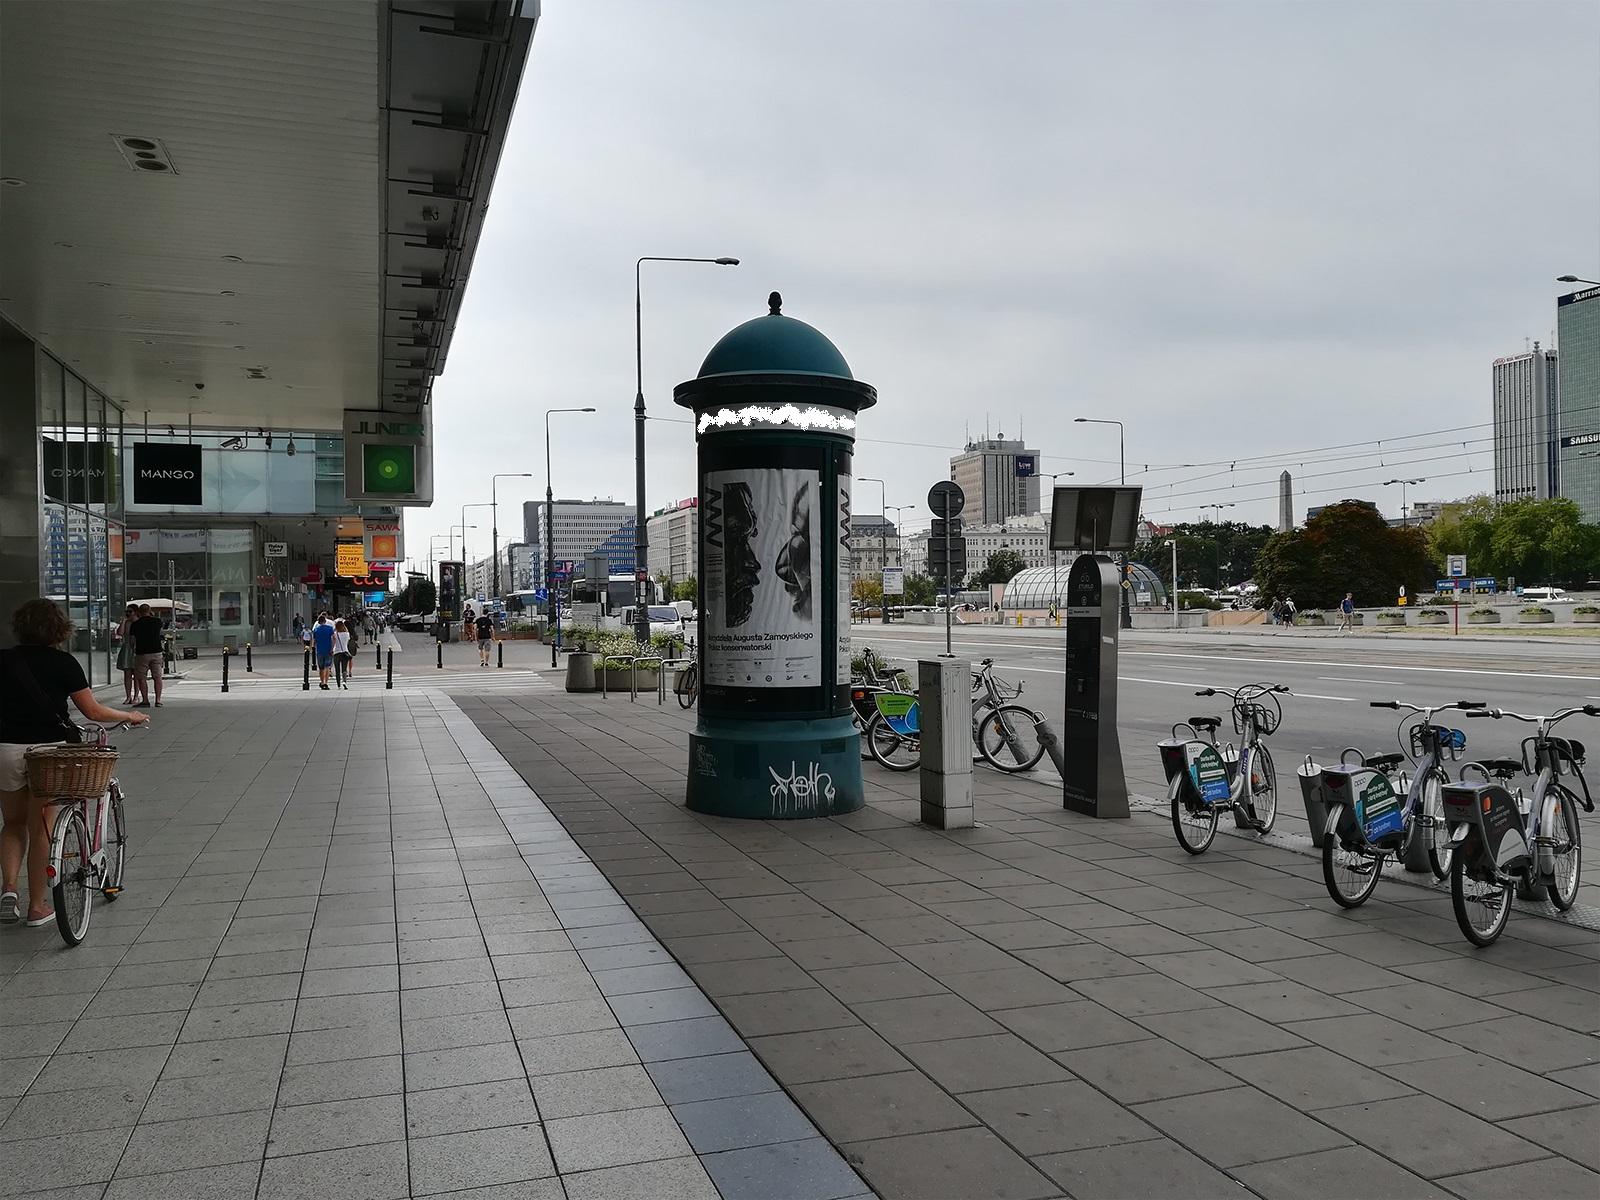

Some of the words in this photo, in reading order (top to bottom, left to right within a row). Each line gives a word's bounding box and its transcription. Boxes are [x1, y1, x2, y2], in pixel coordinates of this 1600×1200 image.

[1570, 434, 1600, 445] SAMSU
[141, 469, 194, 480] MANGO
[733, 634, 762, 643] Augusta
[764, 632, 813, 642] Zamoyskiego
